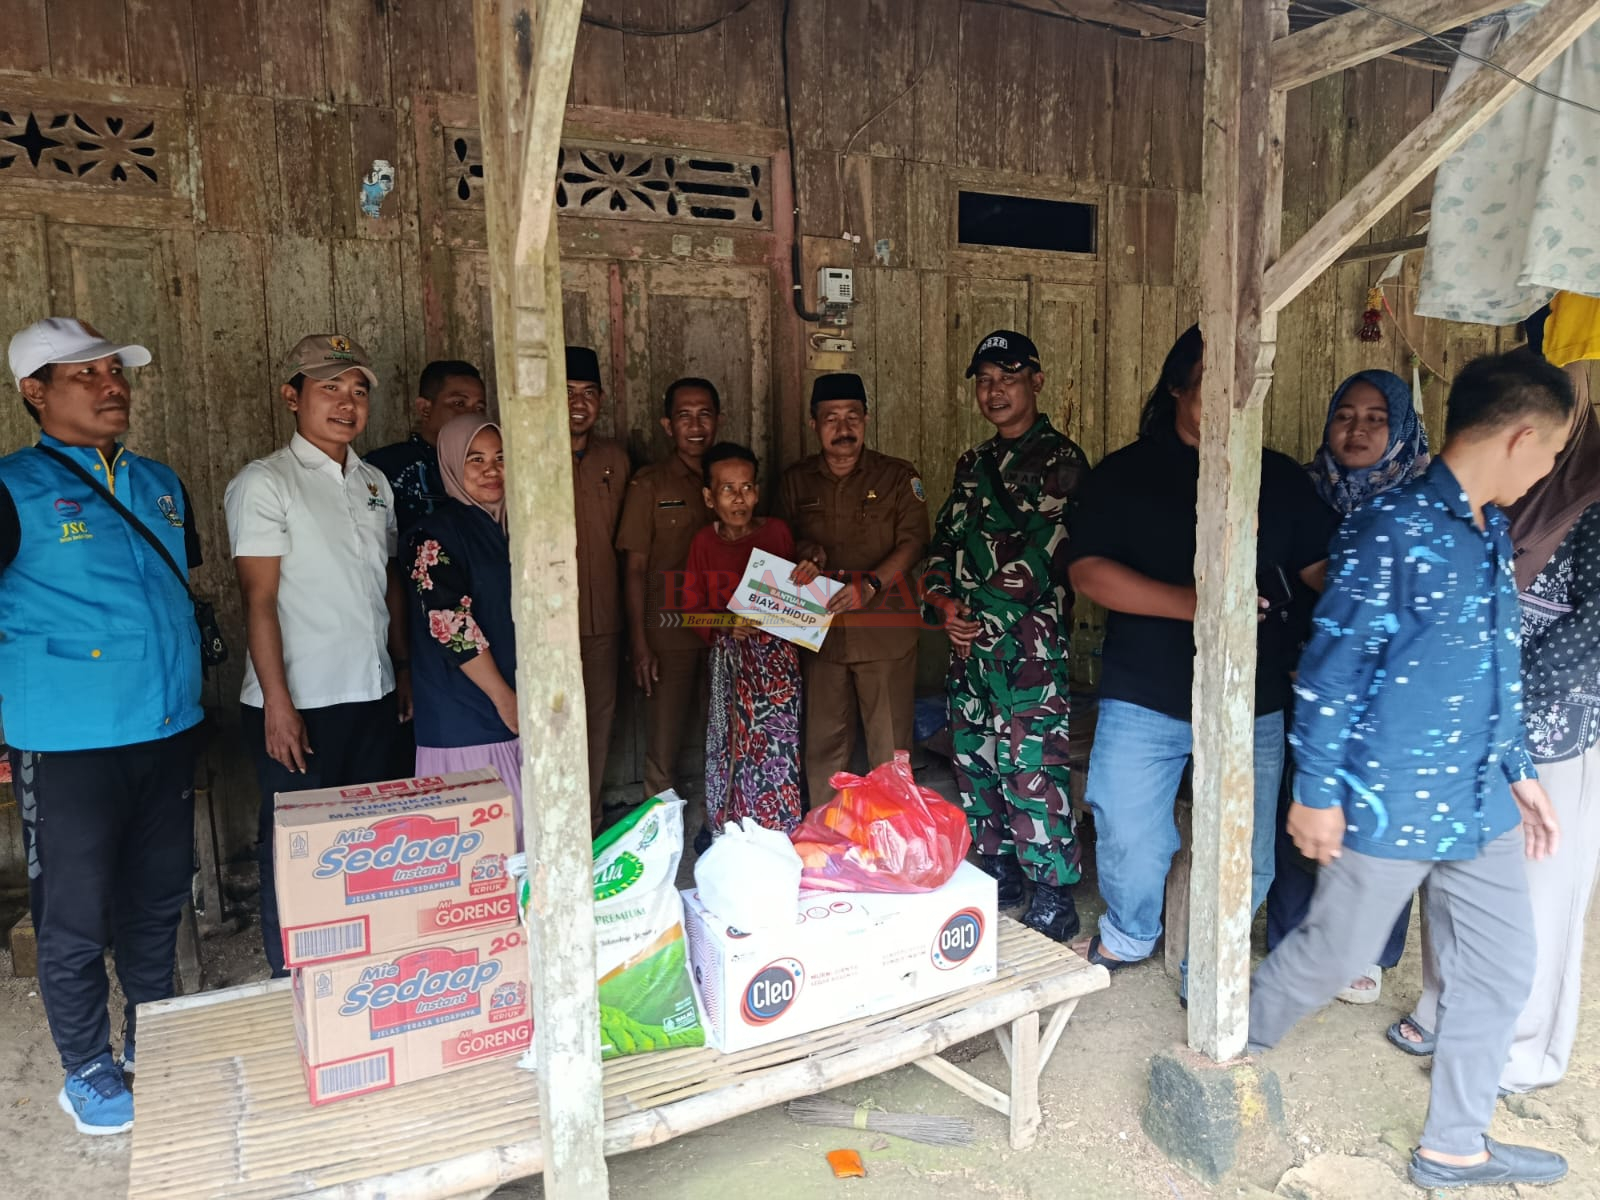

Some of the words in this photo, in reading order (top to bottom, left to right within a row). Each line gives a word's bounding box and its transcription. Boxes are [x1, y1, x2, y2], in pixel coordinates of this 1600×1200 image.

[62, 521, 87, 537] JSC
[748, 593, 780, 612] BIAYA
[782, 606, 817, 625] HIDUP
[770, 589, 806, 606] BANTUAN
[353, 795, 441, 811] TUMPUKAN
[402, 797, 468, 812] KARTON
[470, 803, 504, 828] 20
[334, 829, 377, 847] Mie
[313, 831, 483, 879] Sedaap
[393, 862, 447, 882] Instant
[351, 893, 376, 903] JELAS
[380, 887, 410, 898] TERASA
[414, 880, 456, 893] SEDAPNYA
[474, 884, 500, 895] KRIUK
[435, 899, 511, 926] GORENG
[594, 907, 647, 925] PREMIUM
[488, 932, 520, 956] 20
[942, 923, 975, 950] Cleo
[360, 963, 399, 982] Mie
[339, 959, 502, 1016] Sedaap
[753, 979, 793, 1009] Cleo
[416, 992, 467, 1014] Instant
[377, 1027, 400, 1037] JELAS
[403, 1020, 432, 1030] TERASA
[436, 1009, 476, 1023] SEDAPNYA
[457, 1025, 529, 1055] GORENG
